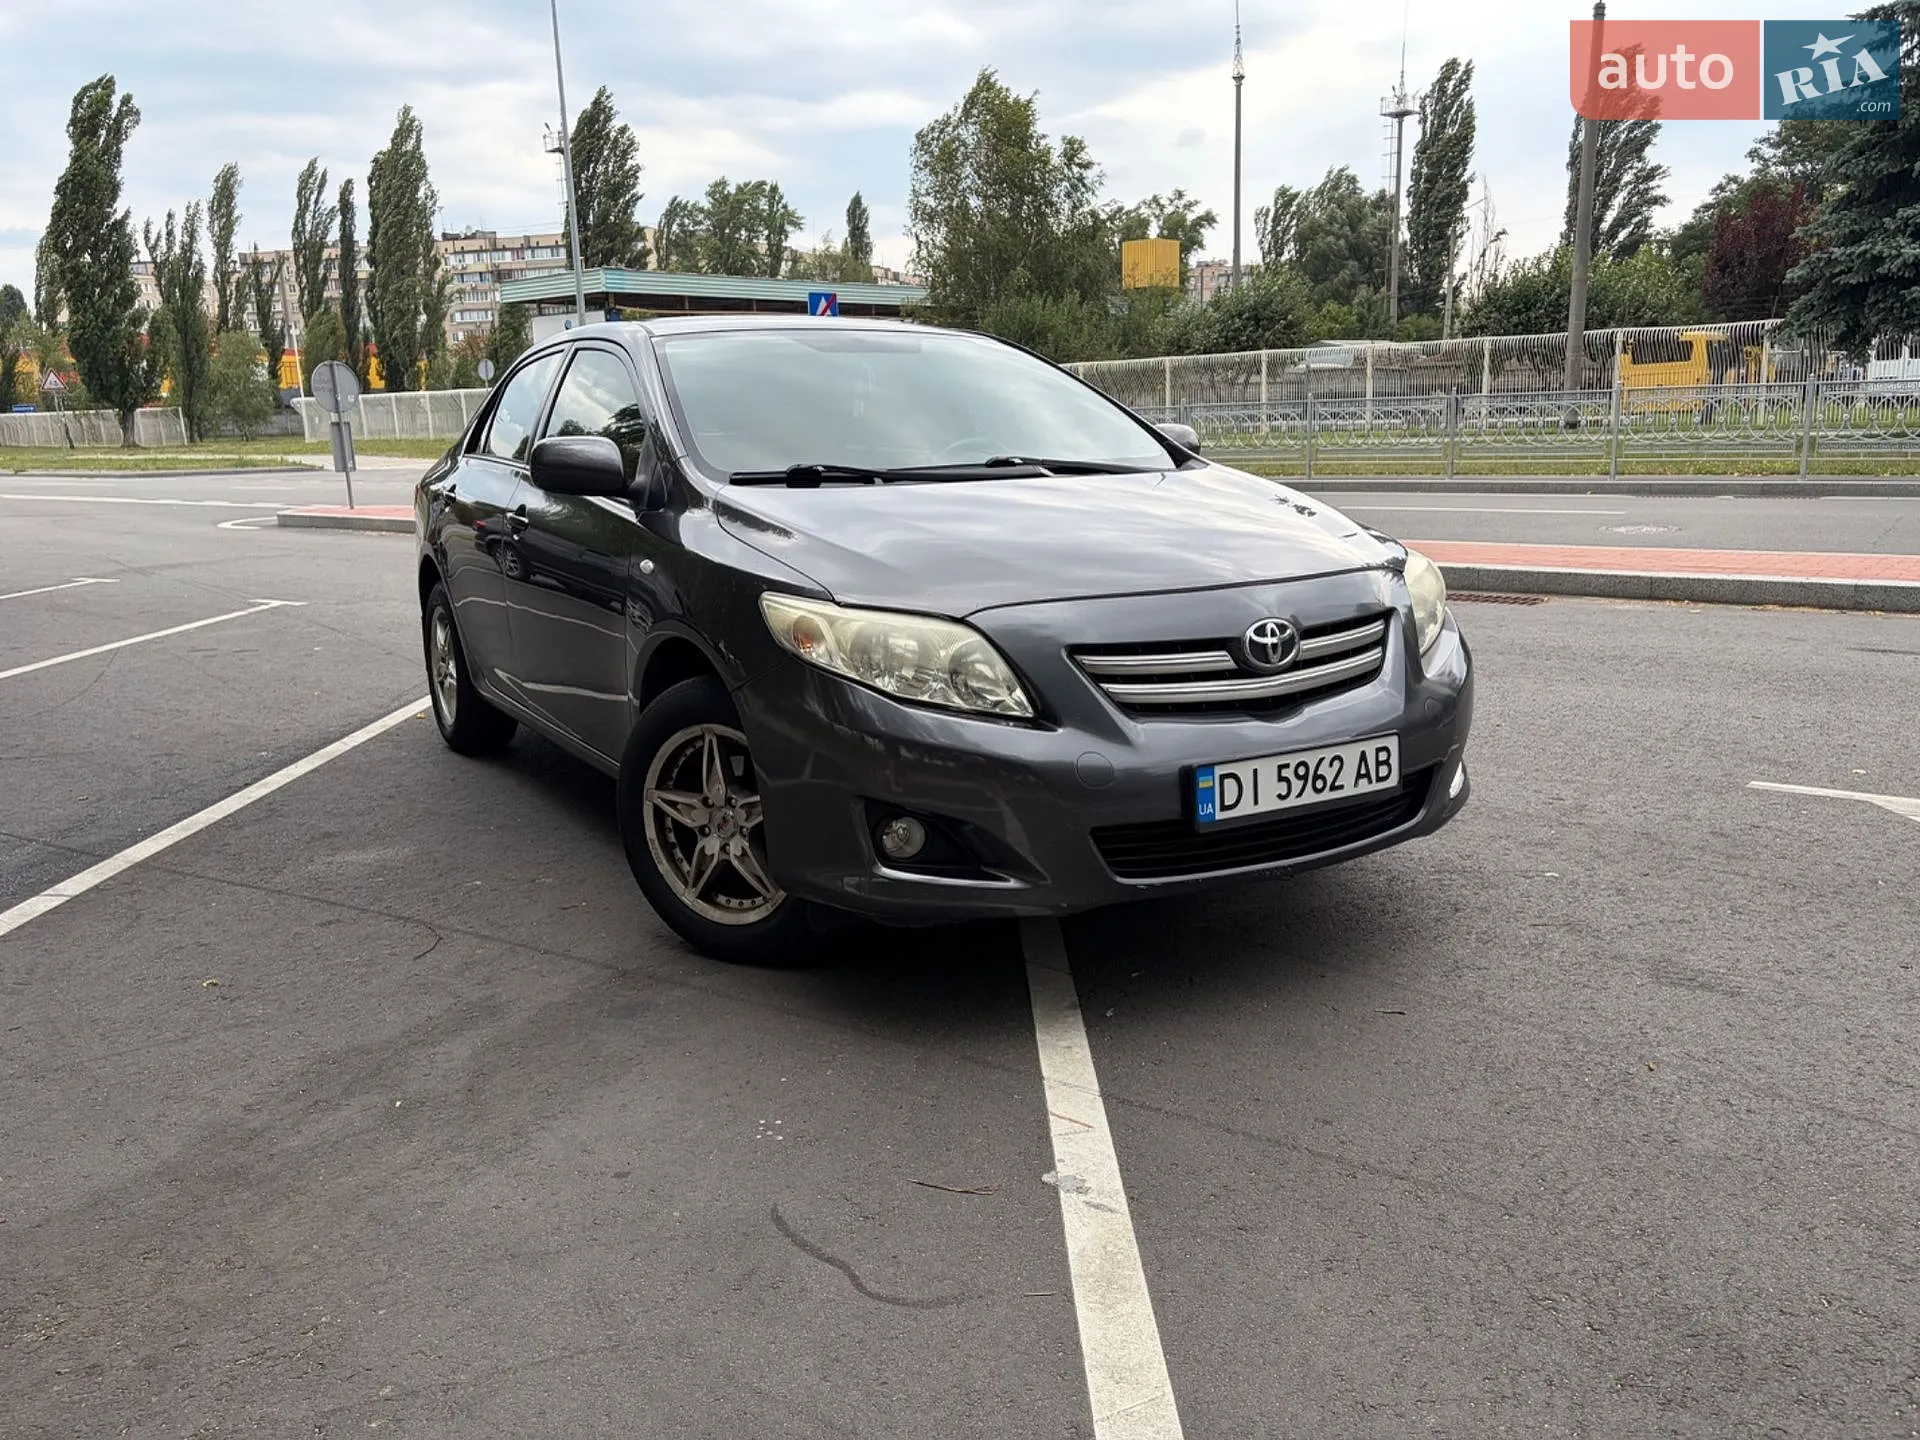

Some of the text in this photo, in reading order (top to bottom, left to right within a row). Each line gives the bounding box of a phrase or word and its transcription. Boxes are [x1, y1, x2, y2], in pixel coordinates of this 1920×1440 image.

[1219, 745, 1392, 812] DI 5962 AB
[1199, 804, 1214, 816] UA
